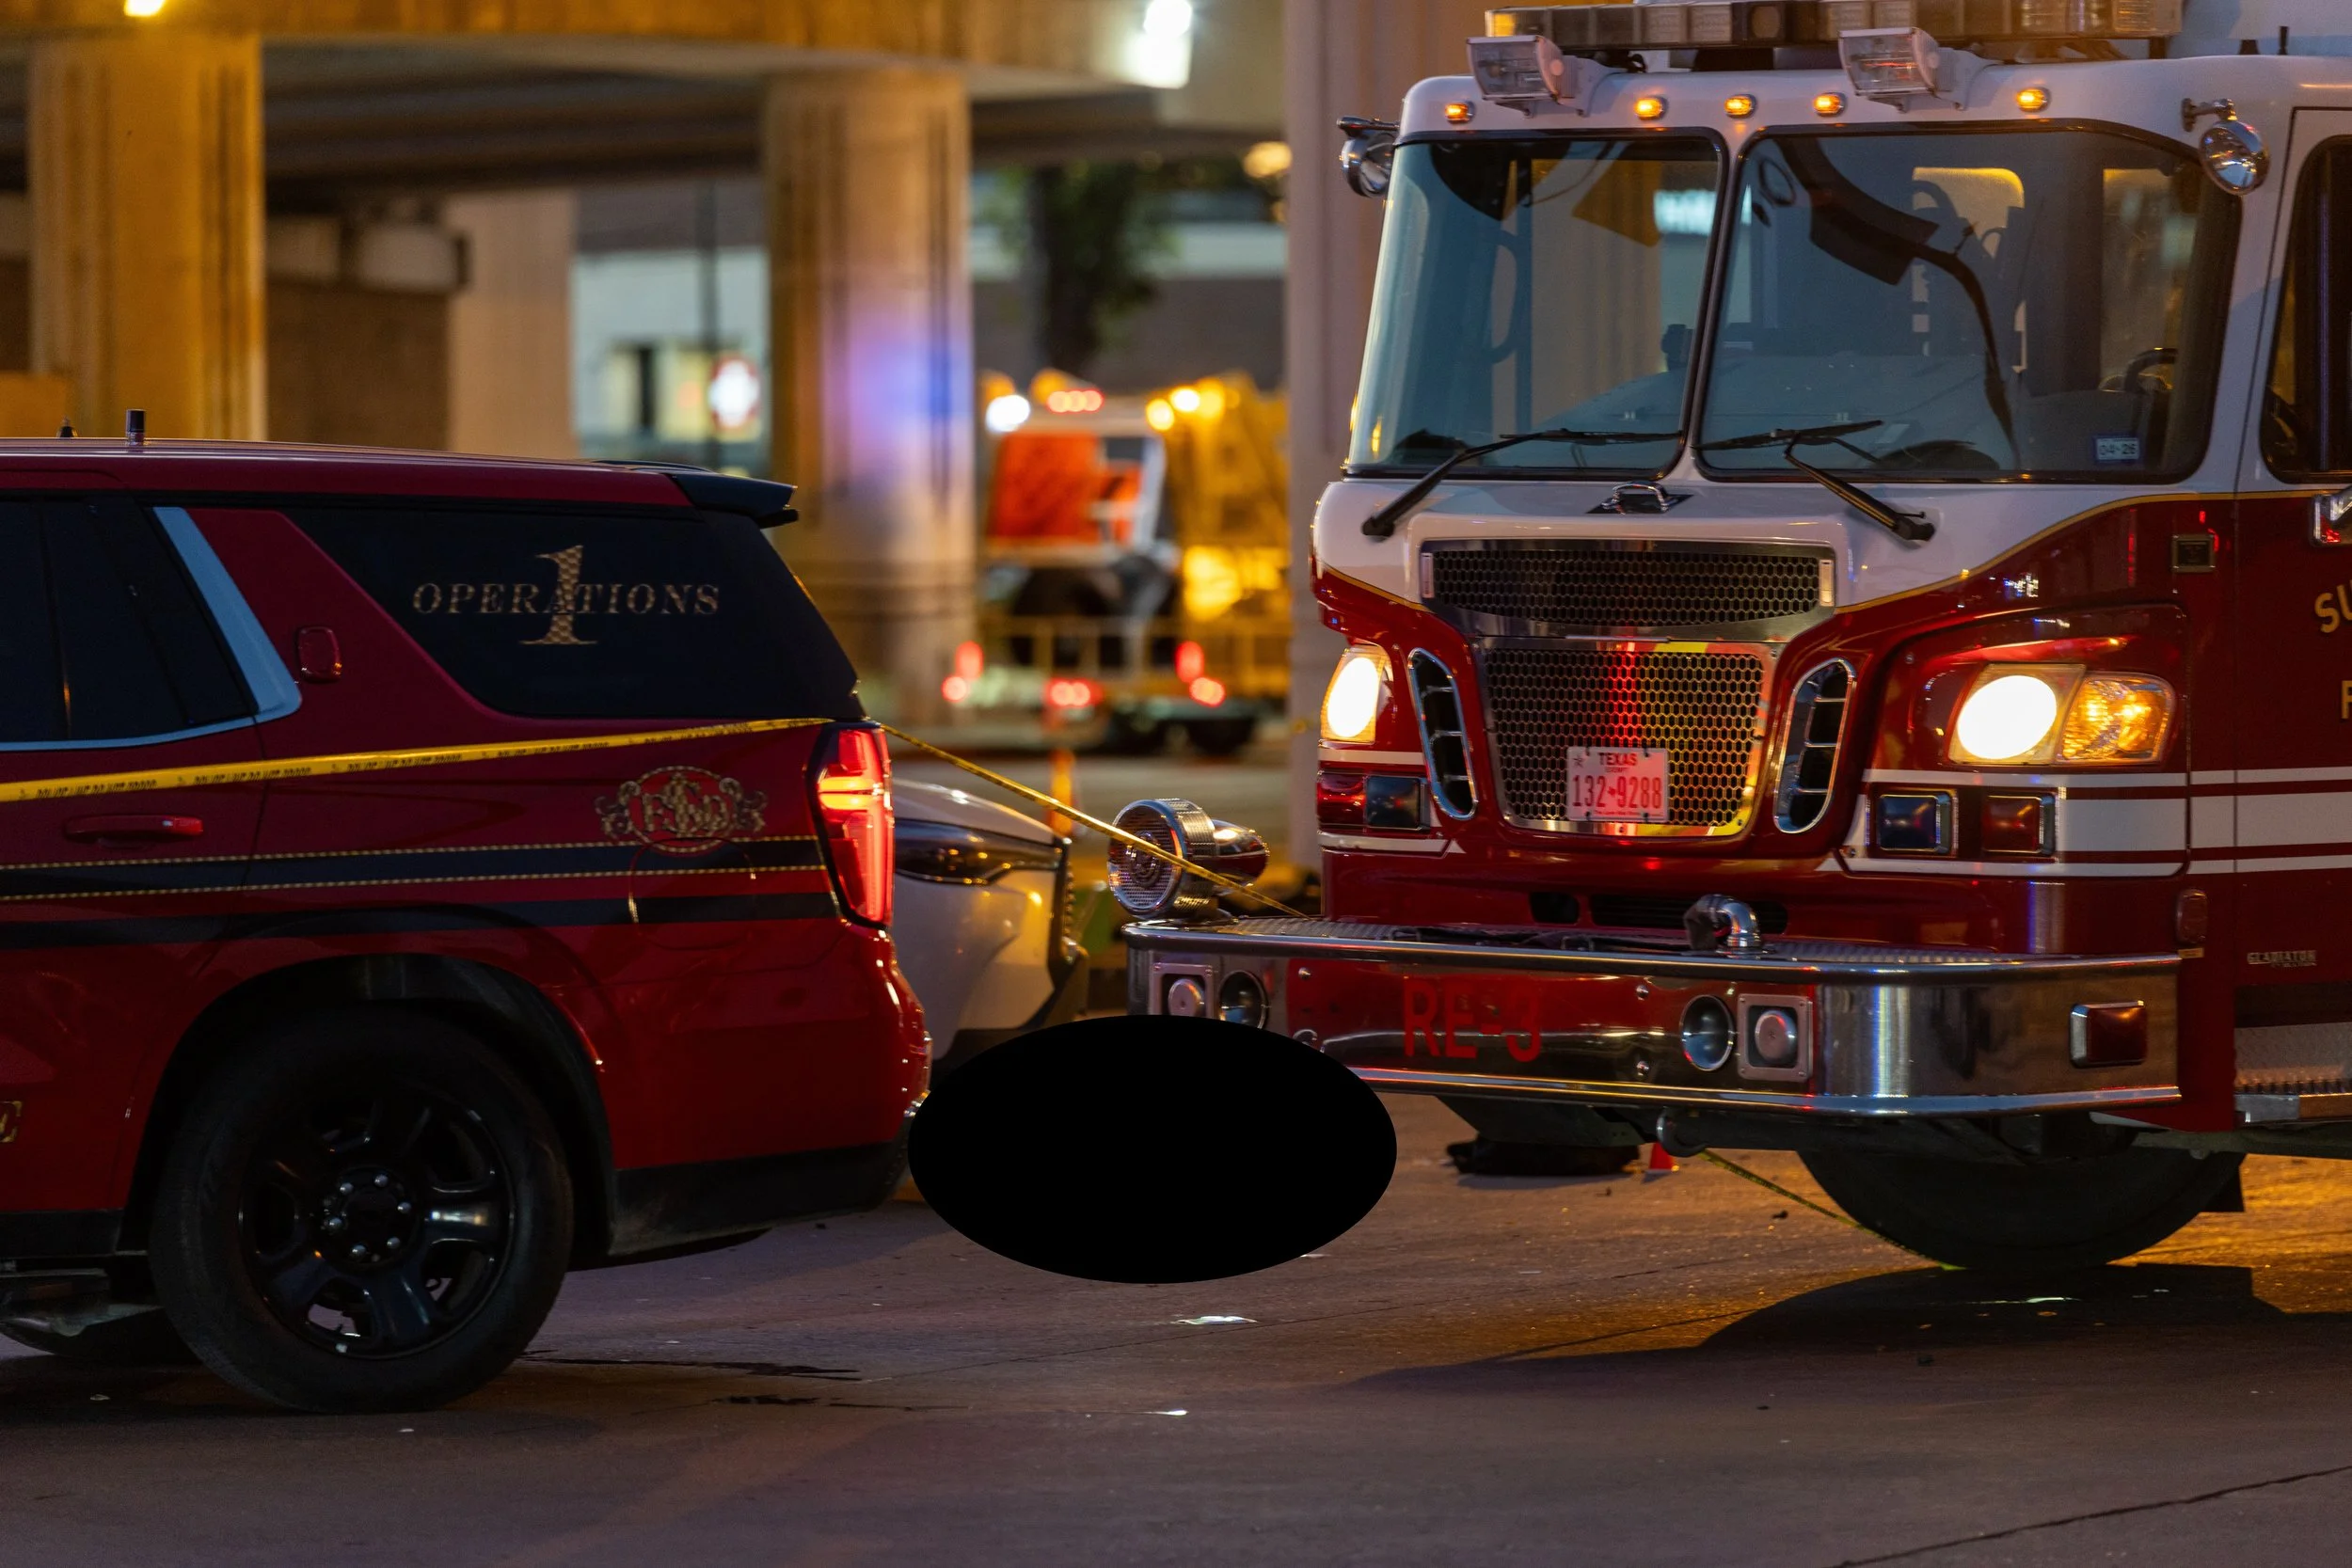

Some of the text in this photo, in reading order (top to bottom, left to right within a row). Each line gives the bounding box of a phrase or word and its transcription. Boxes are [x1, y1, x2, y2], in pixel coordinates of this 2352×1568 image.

[412, 582, 720, 615] OPERATIONS
[518, 545, 598, 645] 1
[1597, 752, 1638, 767] TEXAS
[1403, 979, 1543, 1063] RE-3
